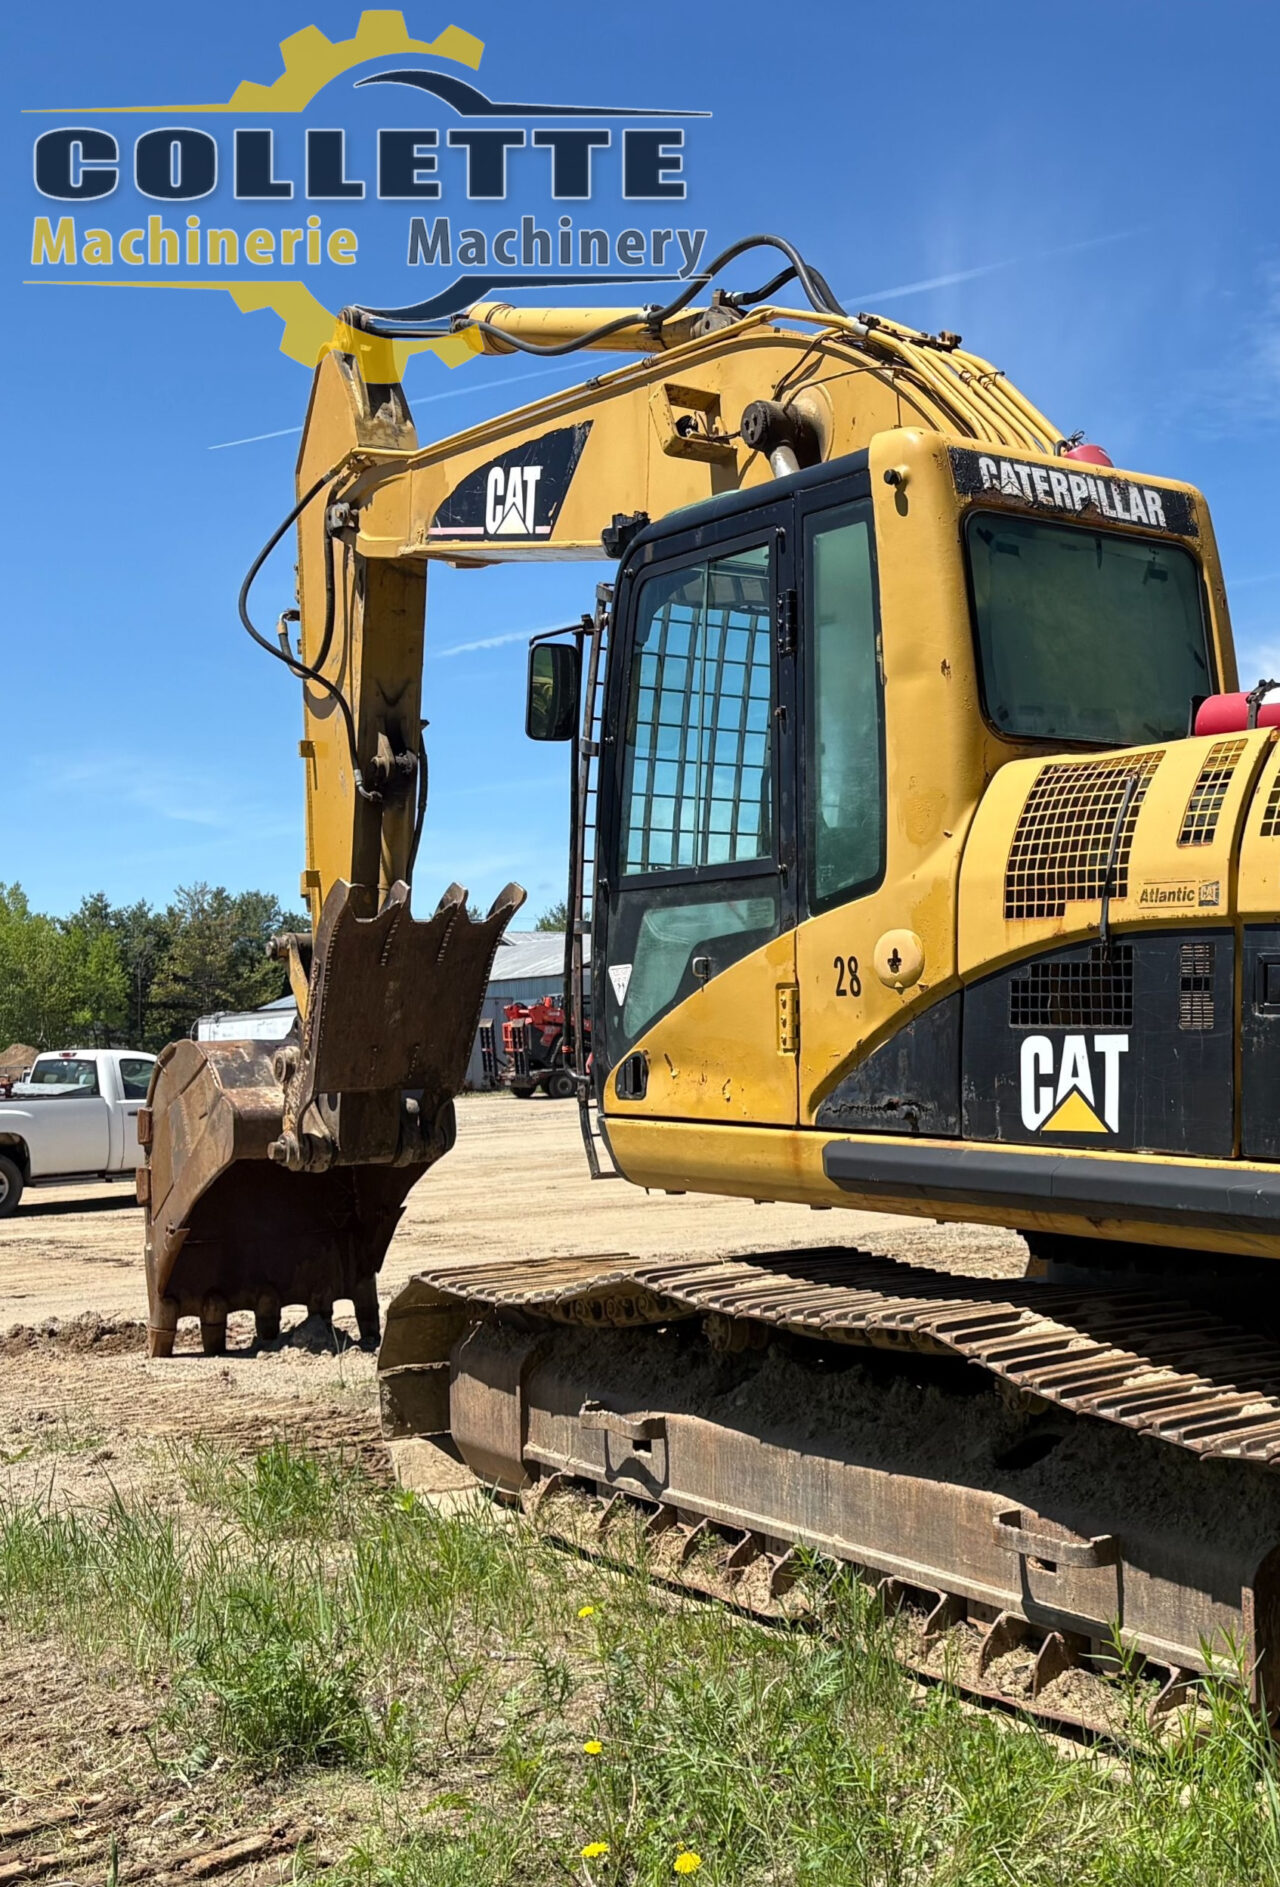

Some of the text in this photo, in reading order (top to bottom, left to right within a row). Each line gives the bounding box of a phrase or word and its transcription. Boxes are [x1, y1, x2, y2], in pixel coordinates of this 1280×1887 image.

[486, 466, 542, 535] CAT
[978, 456, 1167, 527] CATERPILLAR
[1140, 886, 1195, 903] Atlantic
[833, 956, 862, 997] 28
[1020, 1034, 1129, 1134] CAT
